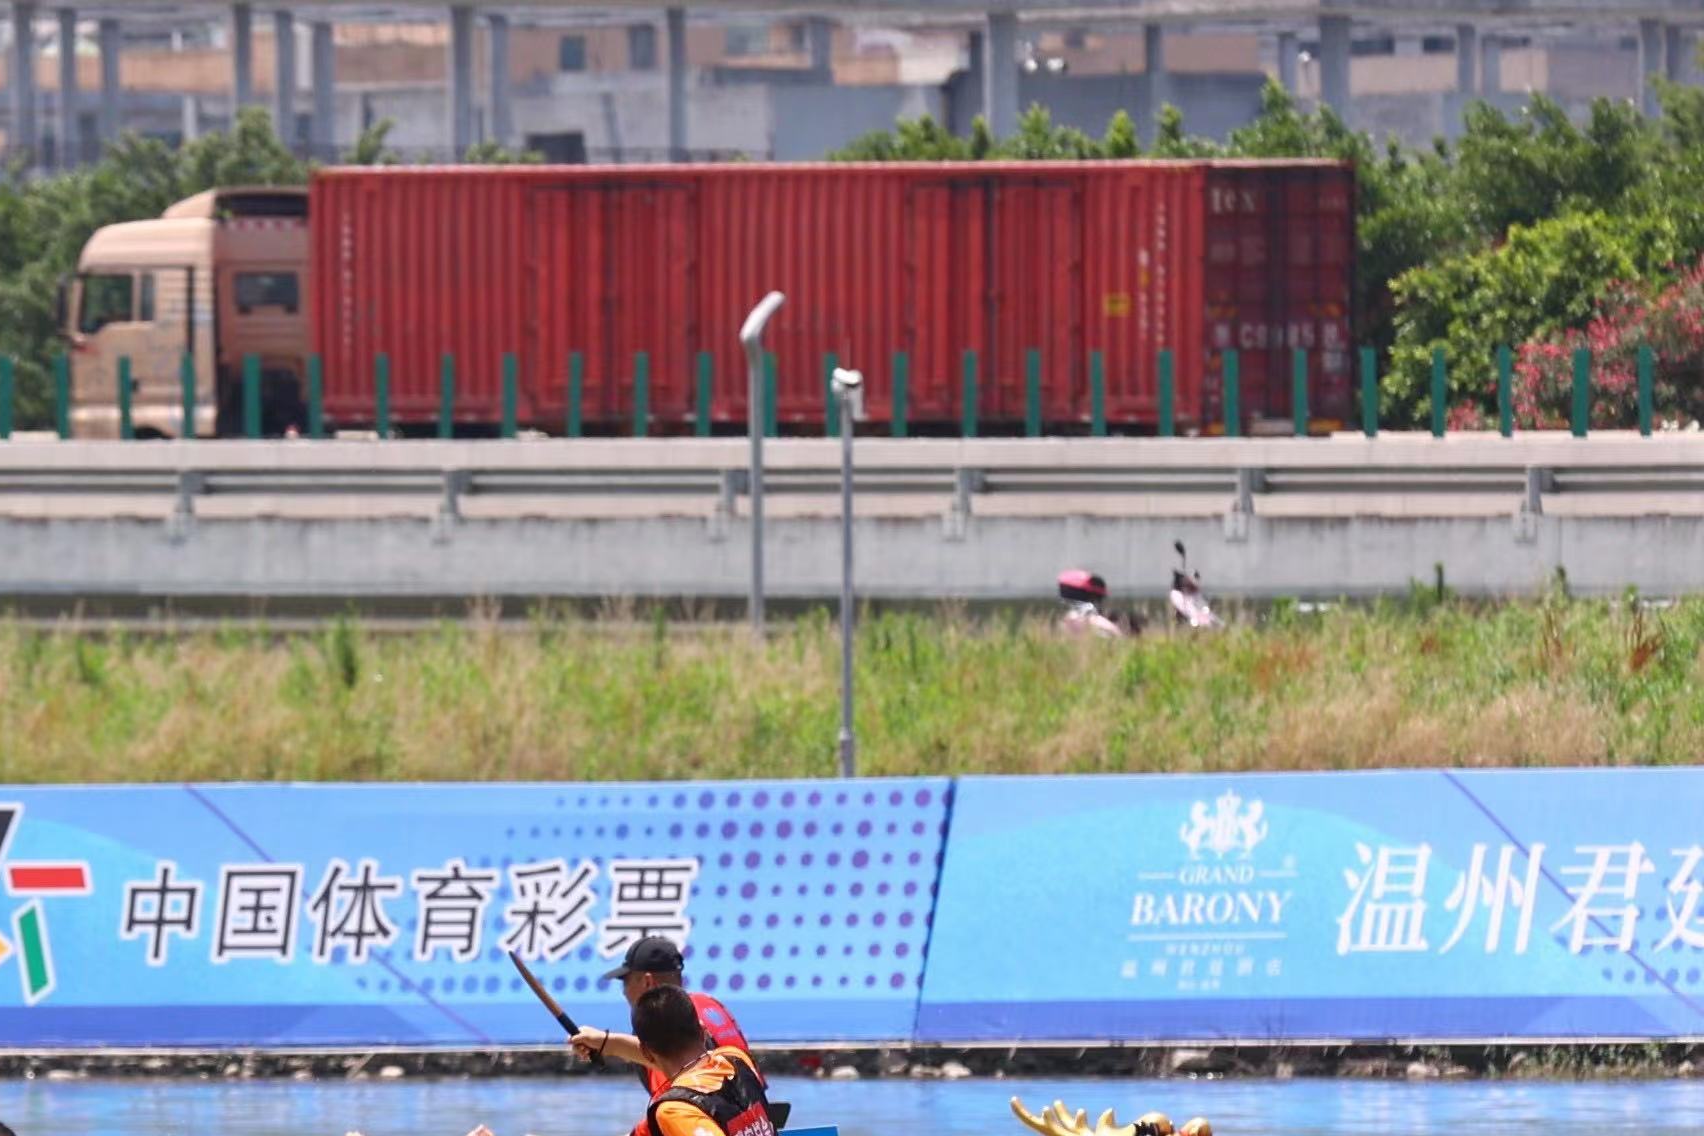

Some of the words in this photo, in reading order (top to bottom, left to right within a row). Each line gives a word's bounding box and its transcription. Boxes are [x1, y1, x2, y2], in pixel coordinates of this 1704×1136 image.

[1179, 865, 1255, 885] GRAND
[121, 857, 697, 964] 中国体育彩票
[1130, 890, 1292, 926] BARONY
